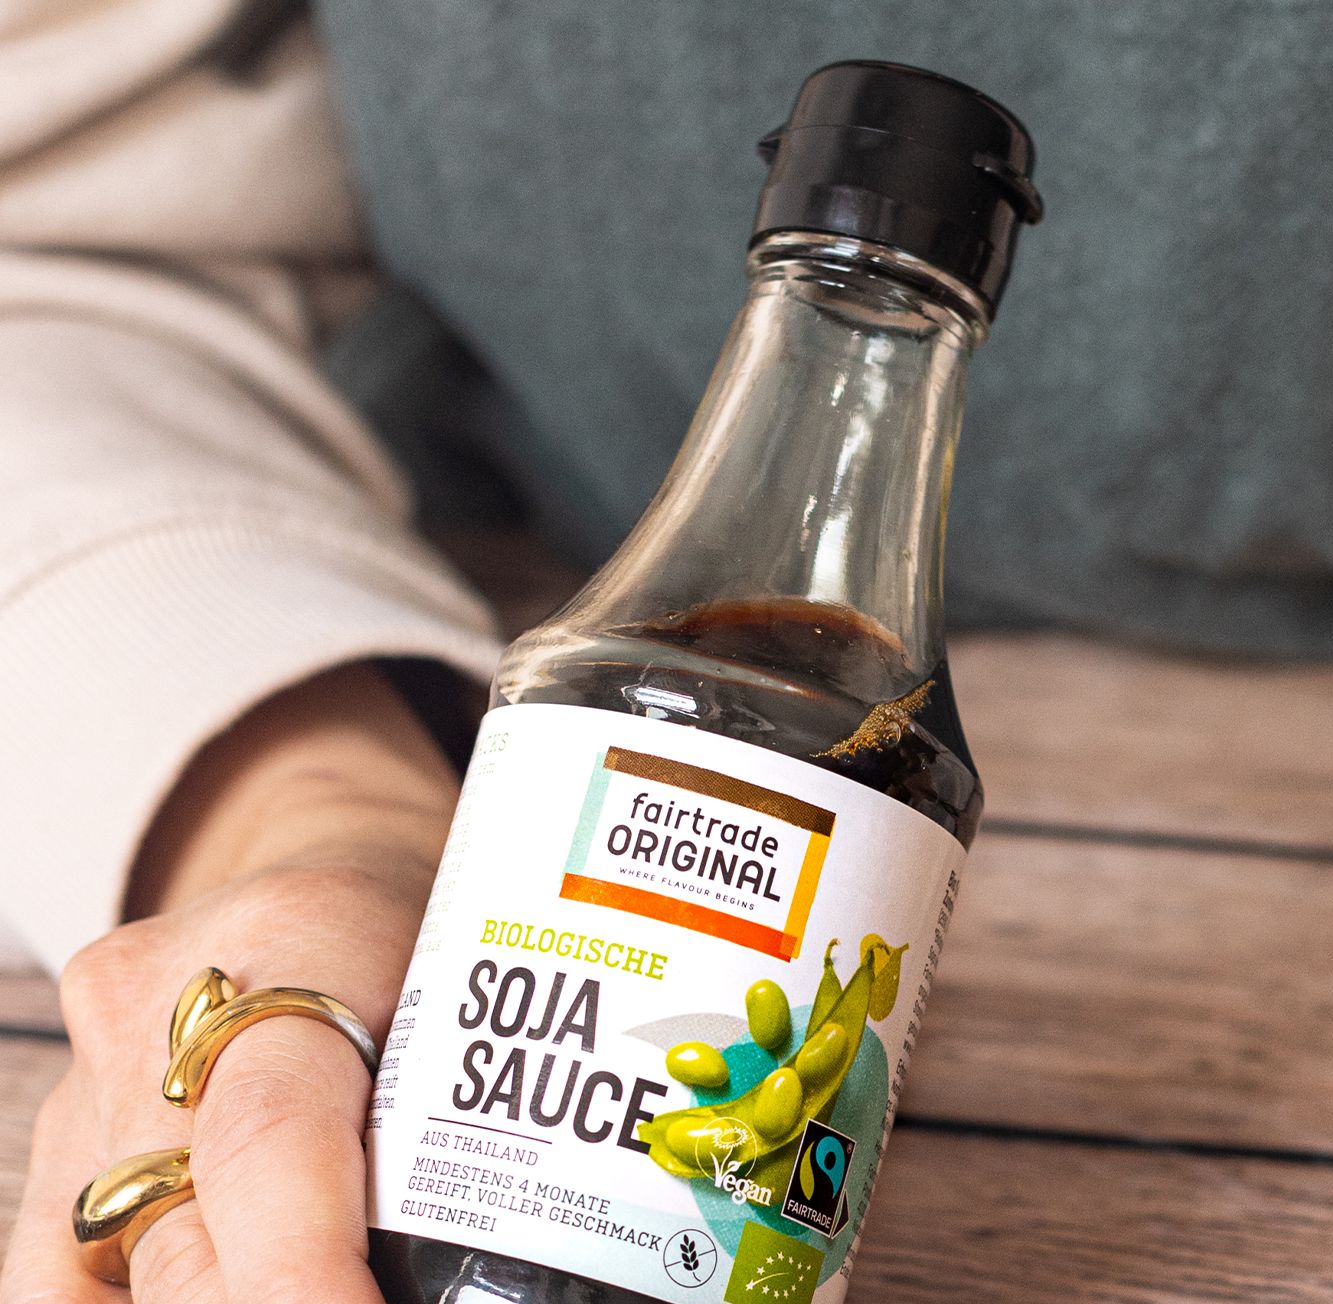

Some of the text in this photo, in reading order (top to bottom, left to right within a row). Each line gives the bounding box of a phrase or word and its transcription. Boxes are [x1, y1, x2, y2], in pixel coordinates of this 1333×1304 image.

[630, 792, 779, 858] fairtrade
[607, 824, 781, 902] ORIGINAL
[619, 866, 755, 911] WHERE FLAVOUR BEGINS
[480, 919, 669, 981] BIOLOGISCHE
[458, 959, 601, 1054] SOJA
[452, 1039, 669, 1155] SAUCE
[420, 1130, 539, 1166] AUS THAILAND
[413, 1156, 611, 1215] MINDESTENS 4 MONATE
[710, 1152, 773, 1206] Vegan
[400, 1199, 498, 1233] GLUTENFREI
[478, 1188, 545, 1218] VOLLER
[548, 1207, 663, 1252] GESCHMACK
[787, 1199, 833, 1229] FAIRTRADE
